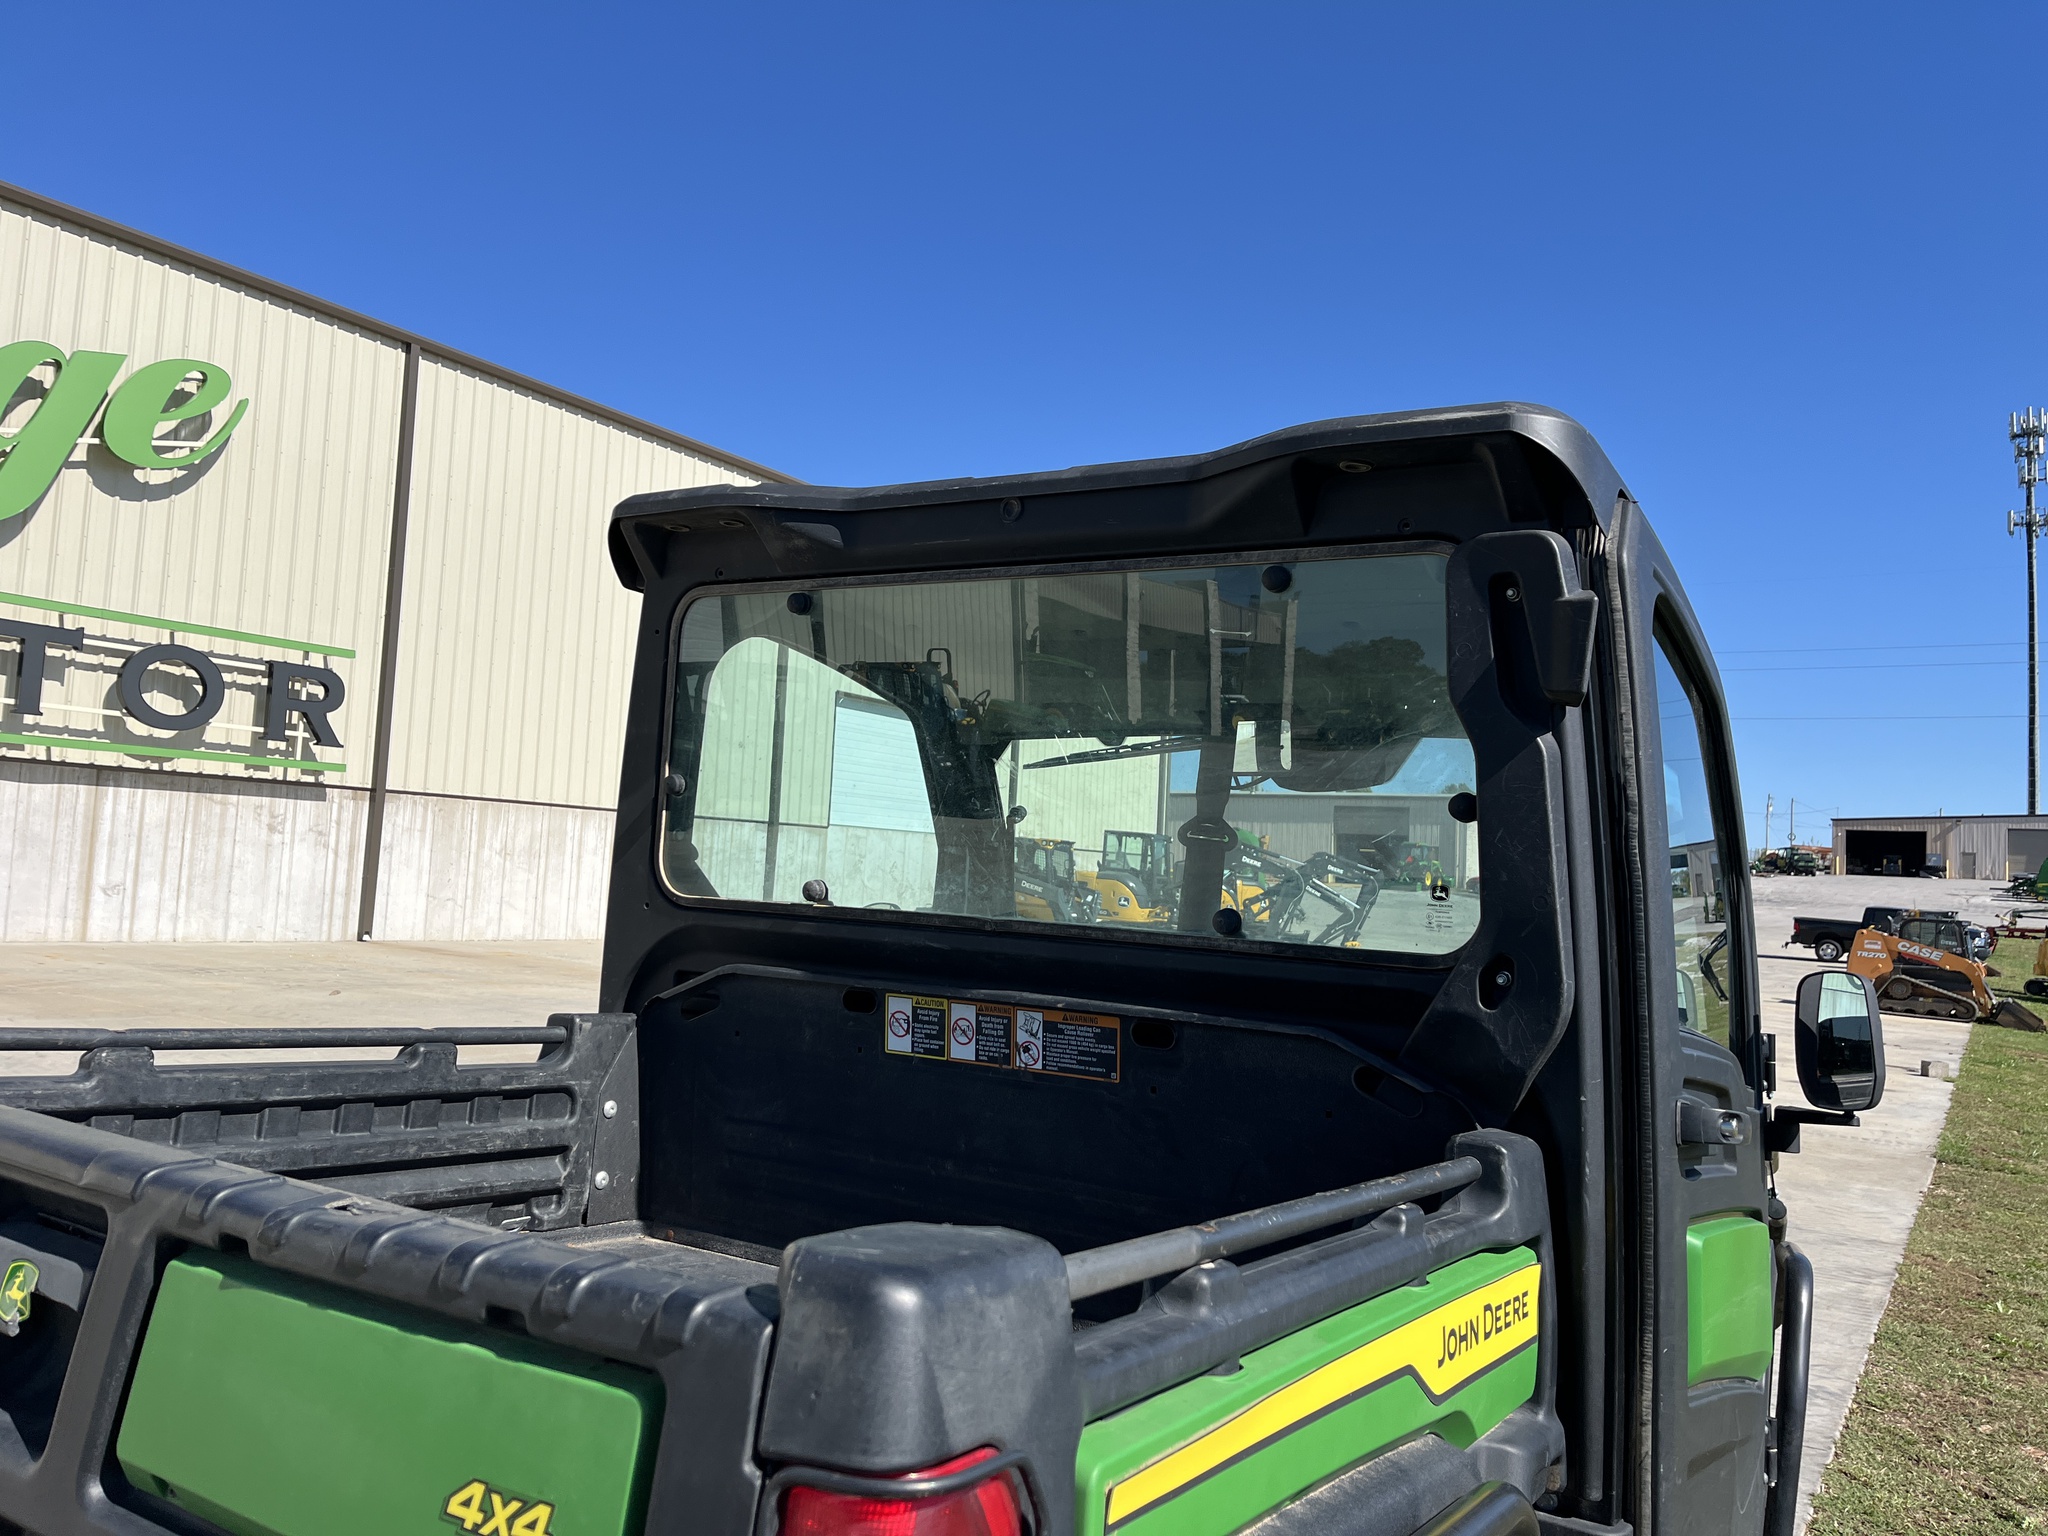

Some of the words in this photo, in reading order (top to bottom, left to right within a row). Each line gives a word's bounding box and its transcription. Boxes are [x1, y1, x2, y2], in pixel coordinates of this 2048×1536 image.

[1241, 855, 1262, 868] DEERE
[1327, 864, 1344, 875] DEERE
[1021, 880, 1044, 893] DEERE
[1305, 885, 1322, 897] DEERE
[1856, 950, 1887, 959] TR270
[1898, 942, 1944, 961] CASE
[921, 998, 944, 1008] CAUTION
[984, 1005, 1011, 1015] WARNING
[1069, 1013, 1098, 1025] WARNING
[1438, 1314, 1479, 1369] JOHN
[1484, 1290, 1528, 1342] DEERE
